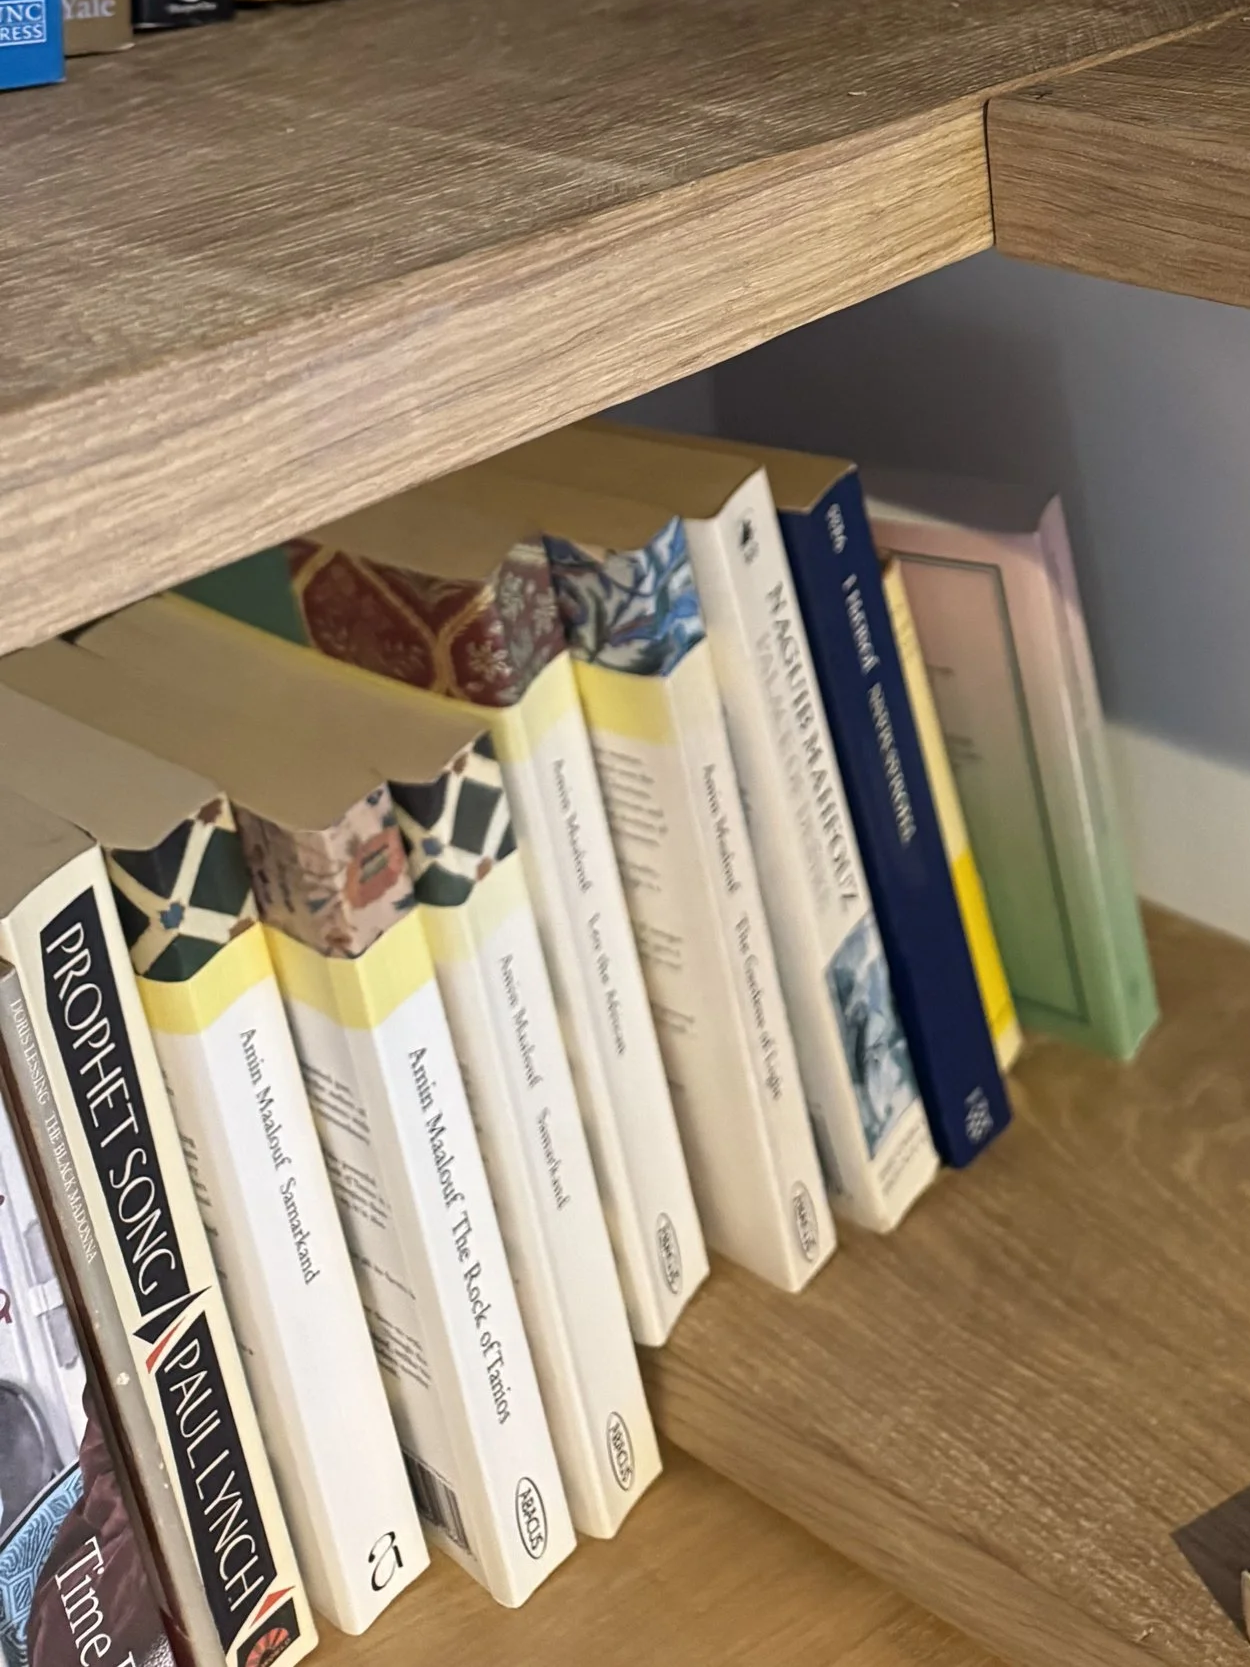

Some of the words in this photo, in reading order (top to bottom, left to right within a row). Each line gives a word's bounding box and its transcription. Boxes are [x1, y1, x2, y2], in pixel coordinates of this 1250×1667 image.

[0, 2, 42, 25] NC
[0, 23, 44, 42] RESS
[45, 921, 140, 1150] PROPHET
[108, 1146, 176, 1297] SONG
[408, 1046, 435, 1114] Amin
[11, 997, 35, 1050] DORIS
[24, 1041, 51, 1107] LESSING
[44, 1114, 60, 1147] THE
[52, 1138, 77, 1187] BLACK
[66, 1181, 98, 1266] MADONNA
[239, 1028, 263, 1087] Amin
[256, 1083, 293, 1172] Maalouf
[279, 1176, 320, 1286] Samarkand
[424, 1111, 466, 1209] Maalouf
[451, 1210, 472, 1263] The
[463, 1260, 493, 1330] Rock
[479, 1331, 502, 1360] of
[486, 1352, 514, 1427] Tanios
[163, 1337, 221, 1470] PAUL
[195, 1449, 266, 1612] LYNCH
[518, 1485, 547, 1553] ABACUS
[54, 1536, 112, 1667] Time
